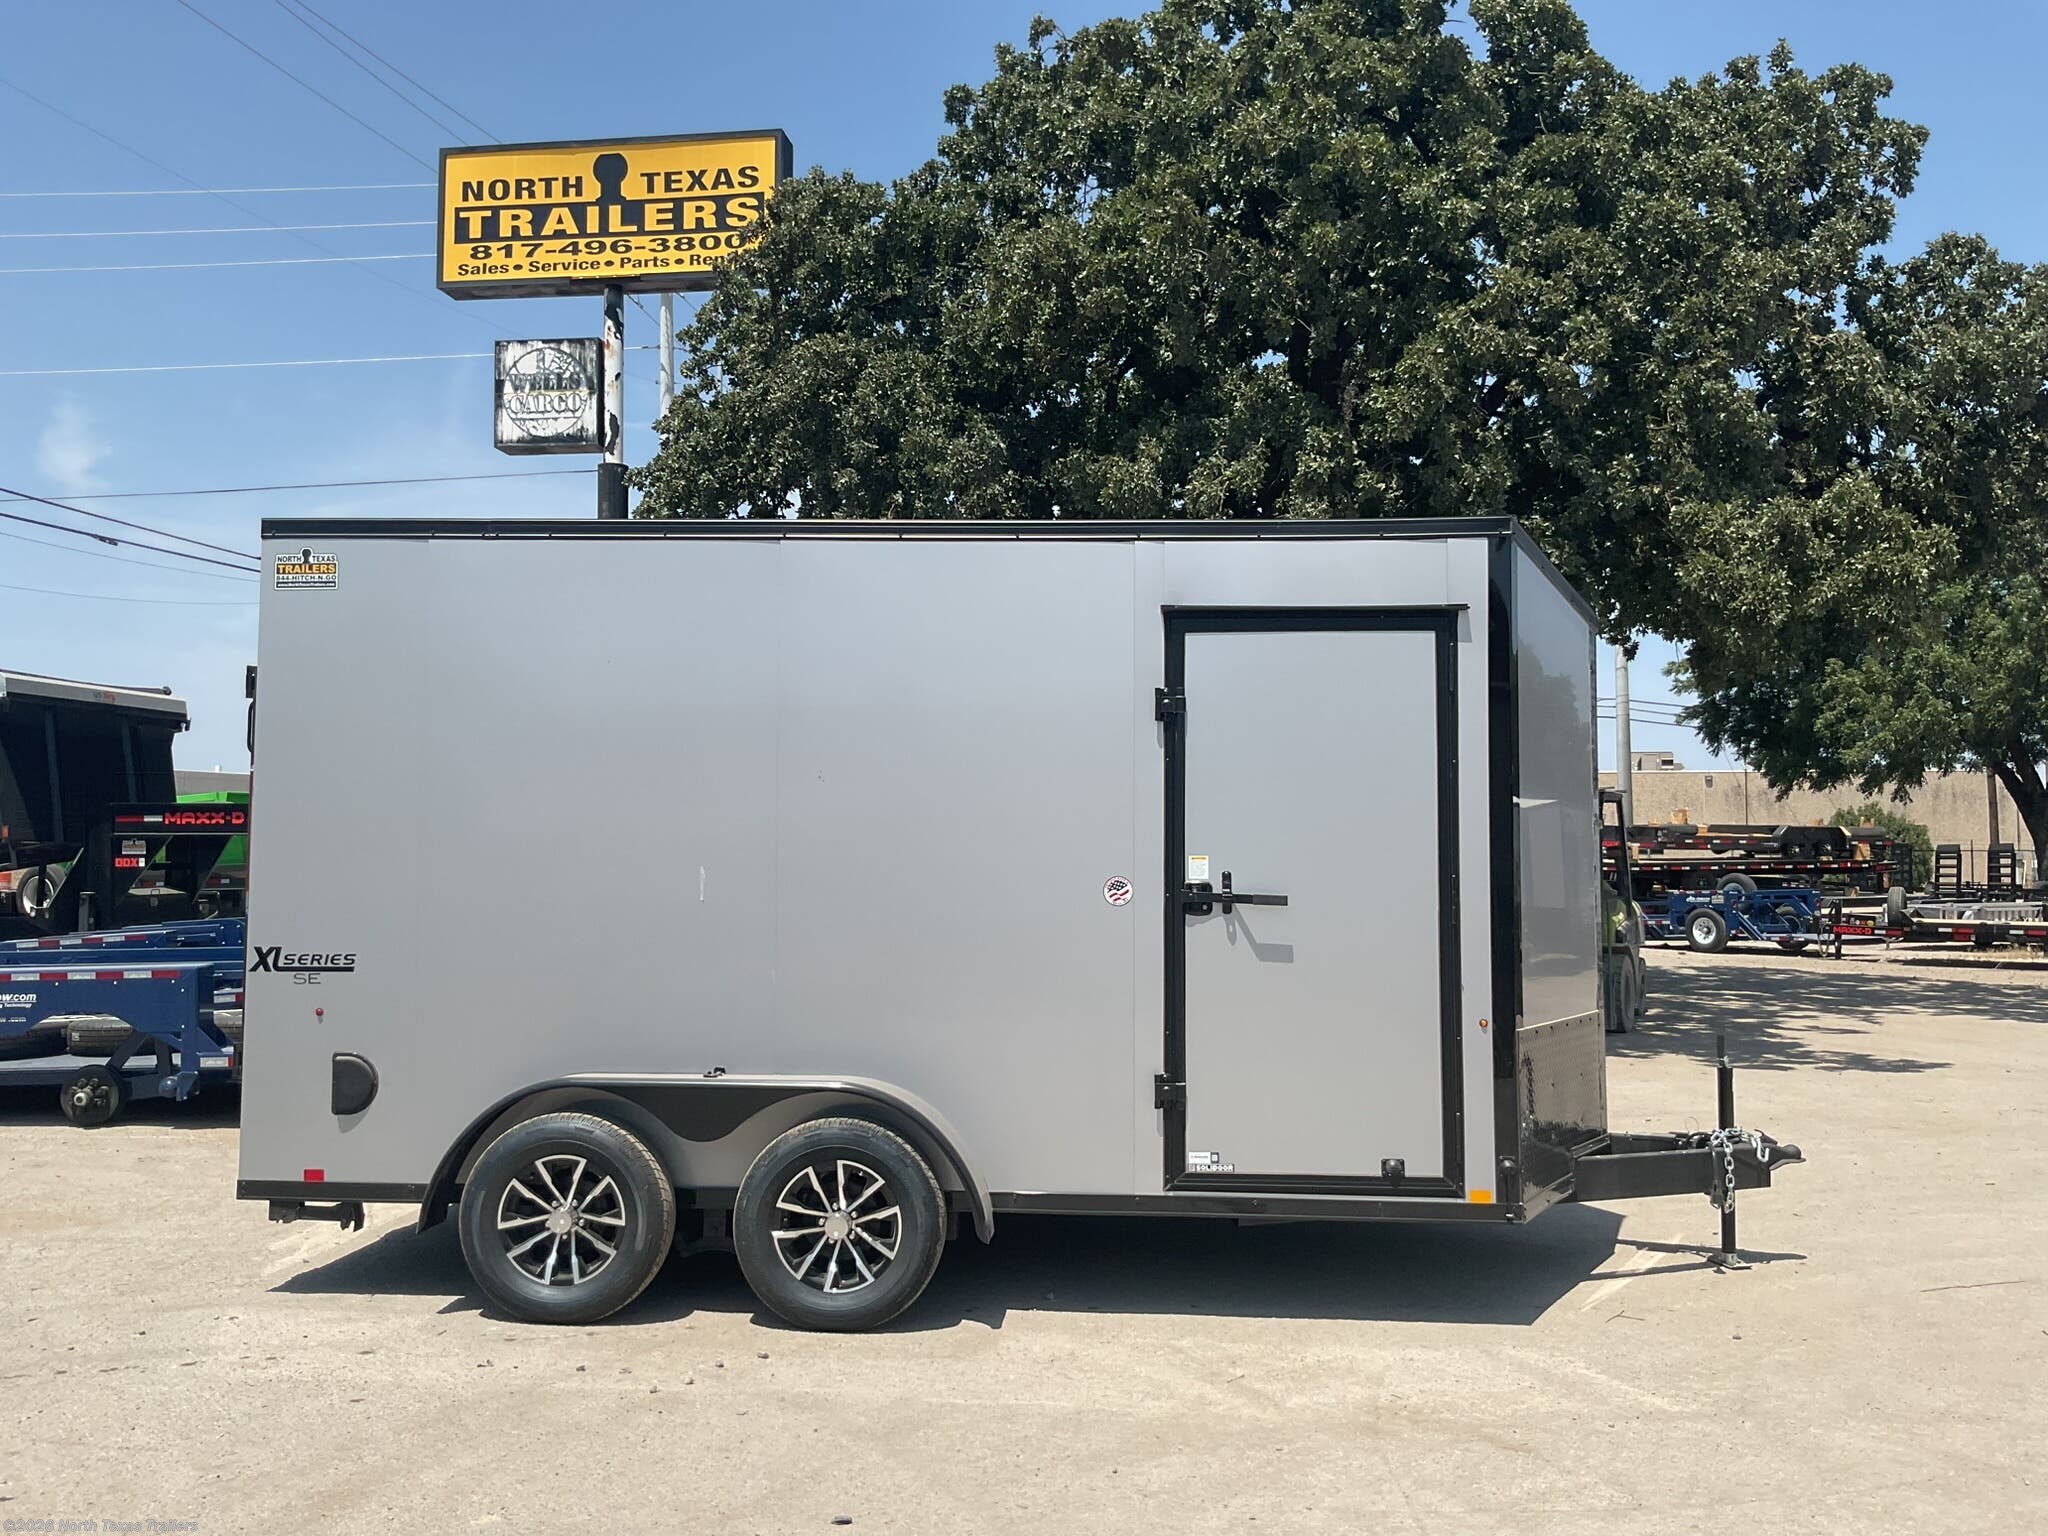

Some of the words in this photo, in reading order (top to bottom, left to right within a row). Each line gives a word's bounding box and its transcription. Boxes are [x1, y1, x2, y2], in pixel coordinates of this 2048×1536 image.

[462, 176, 583, 202] NORTH
[640, 166, 760, 195] TEXAS
[459, 197, 760, 240] TRAILERS
[470, 234, 747, 260] 817-496-3800
[457, 263, 510, 276] Sales
[528, 258, 601, 273] Service
[619, 255, 670, 269] Parts
[509, 392, 582, 414] CARGO
[277, 564, 335, 573] TRAILERS
[164, 812, 245, 825] MAXX-D
[283, 953, 357, 966] SERIES
[293, 973, 321, 985] SE
